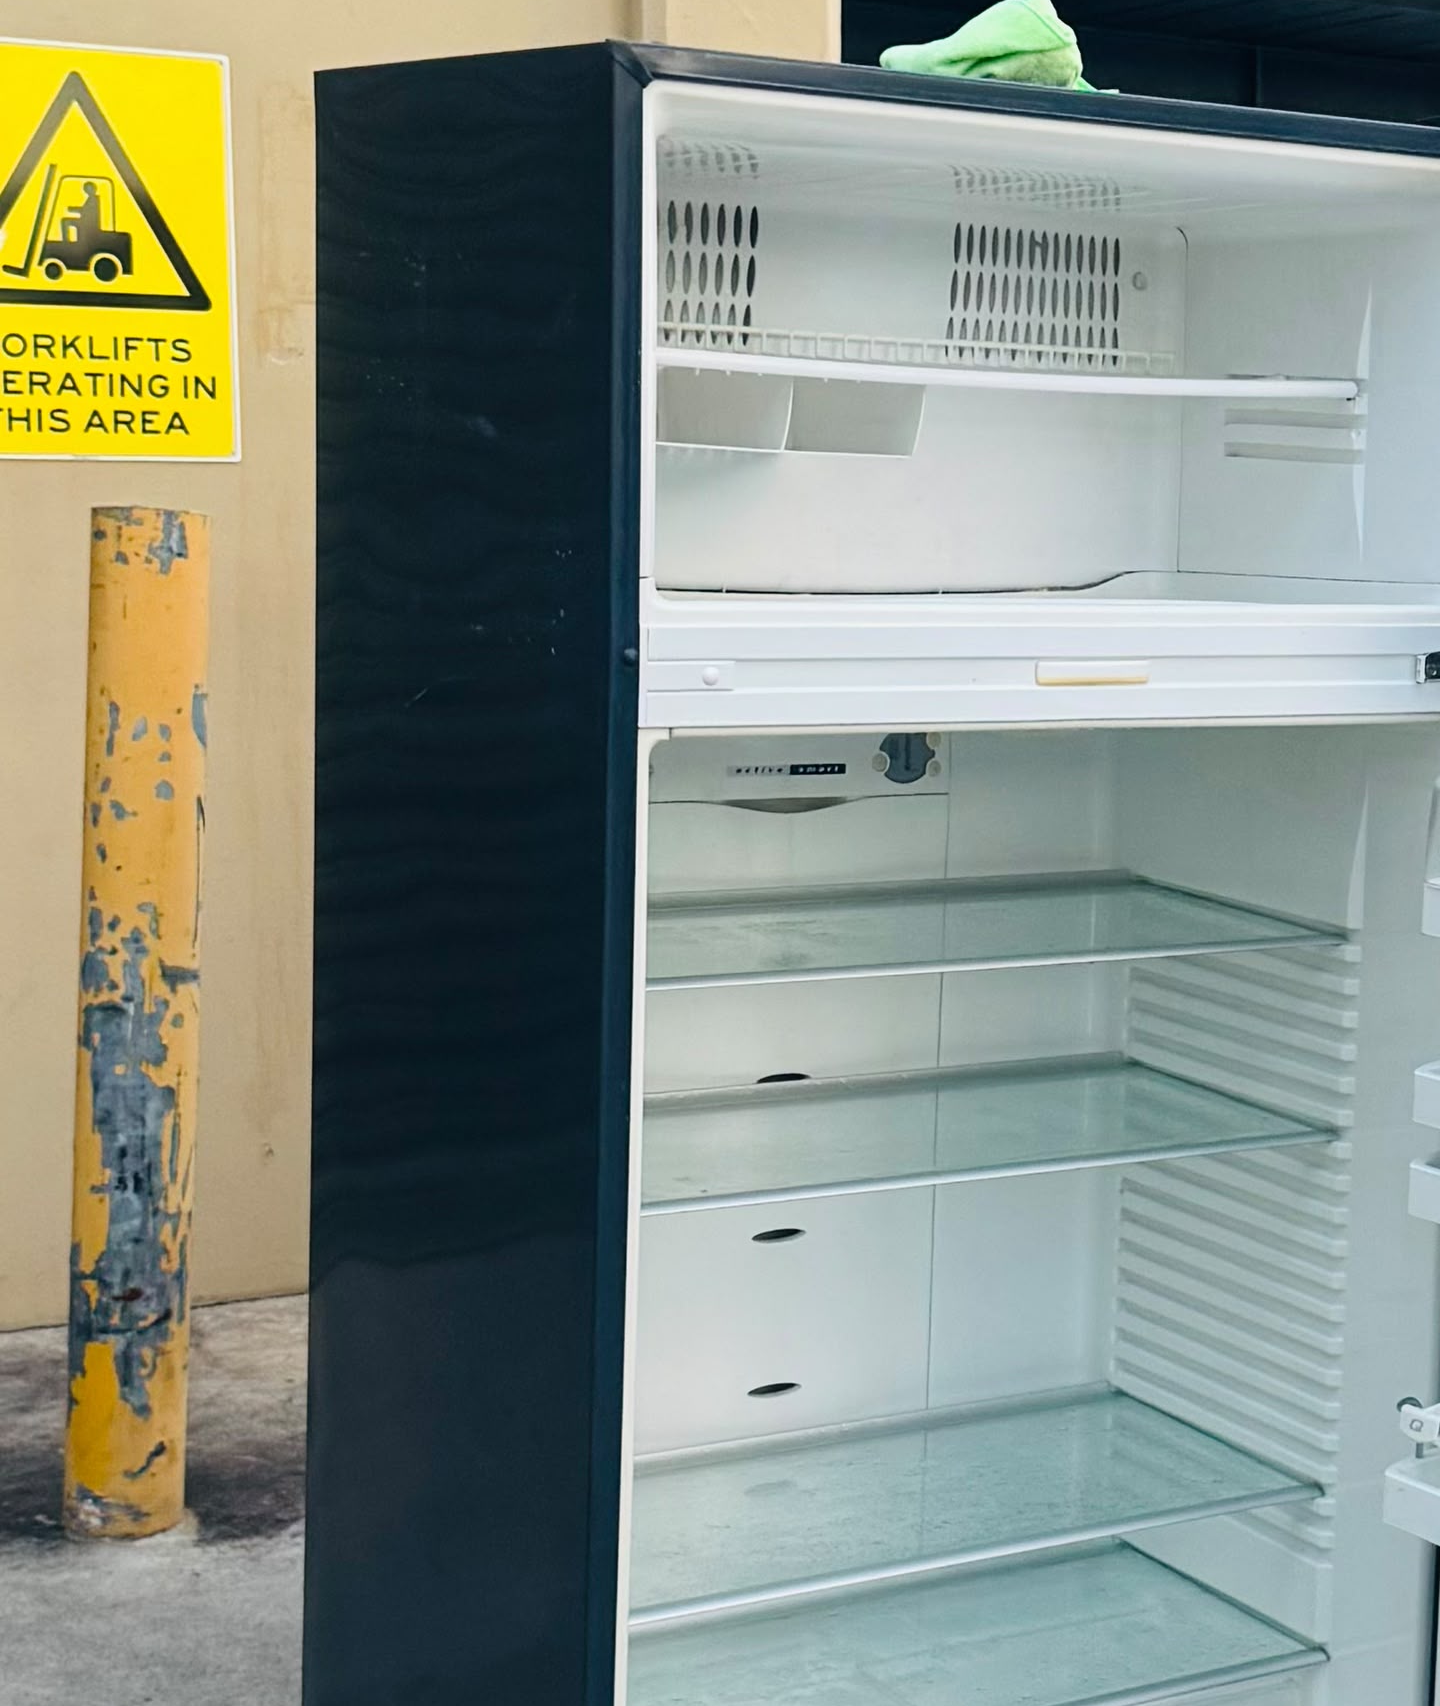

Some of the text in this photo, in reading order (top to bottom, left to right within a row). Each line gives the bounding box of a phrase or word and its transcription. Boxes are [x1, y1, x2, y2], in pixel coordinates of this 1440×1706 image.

[183, 375, 216, 400] IN
[0, 407, 190, 435] HIS AREA
